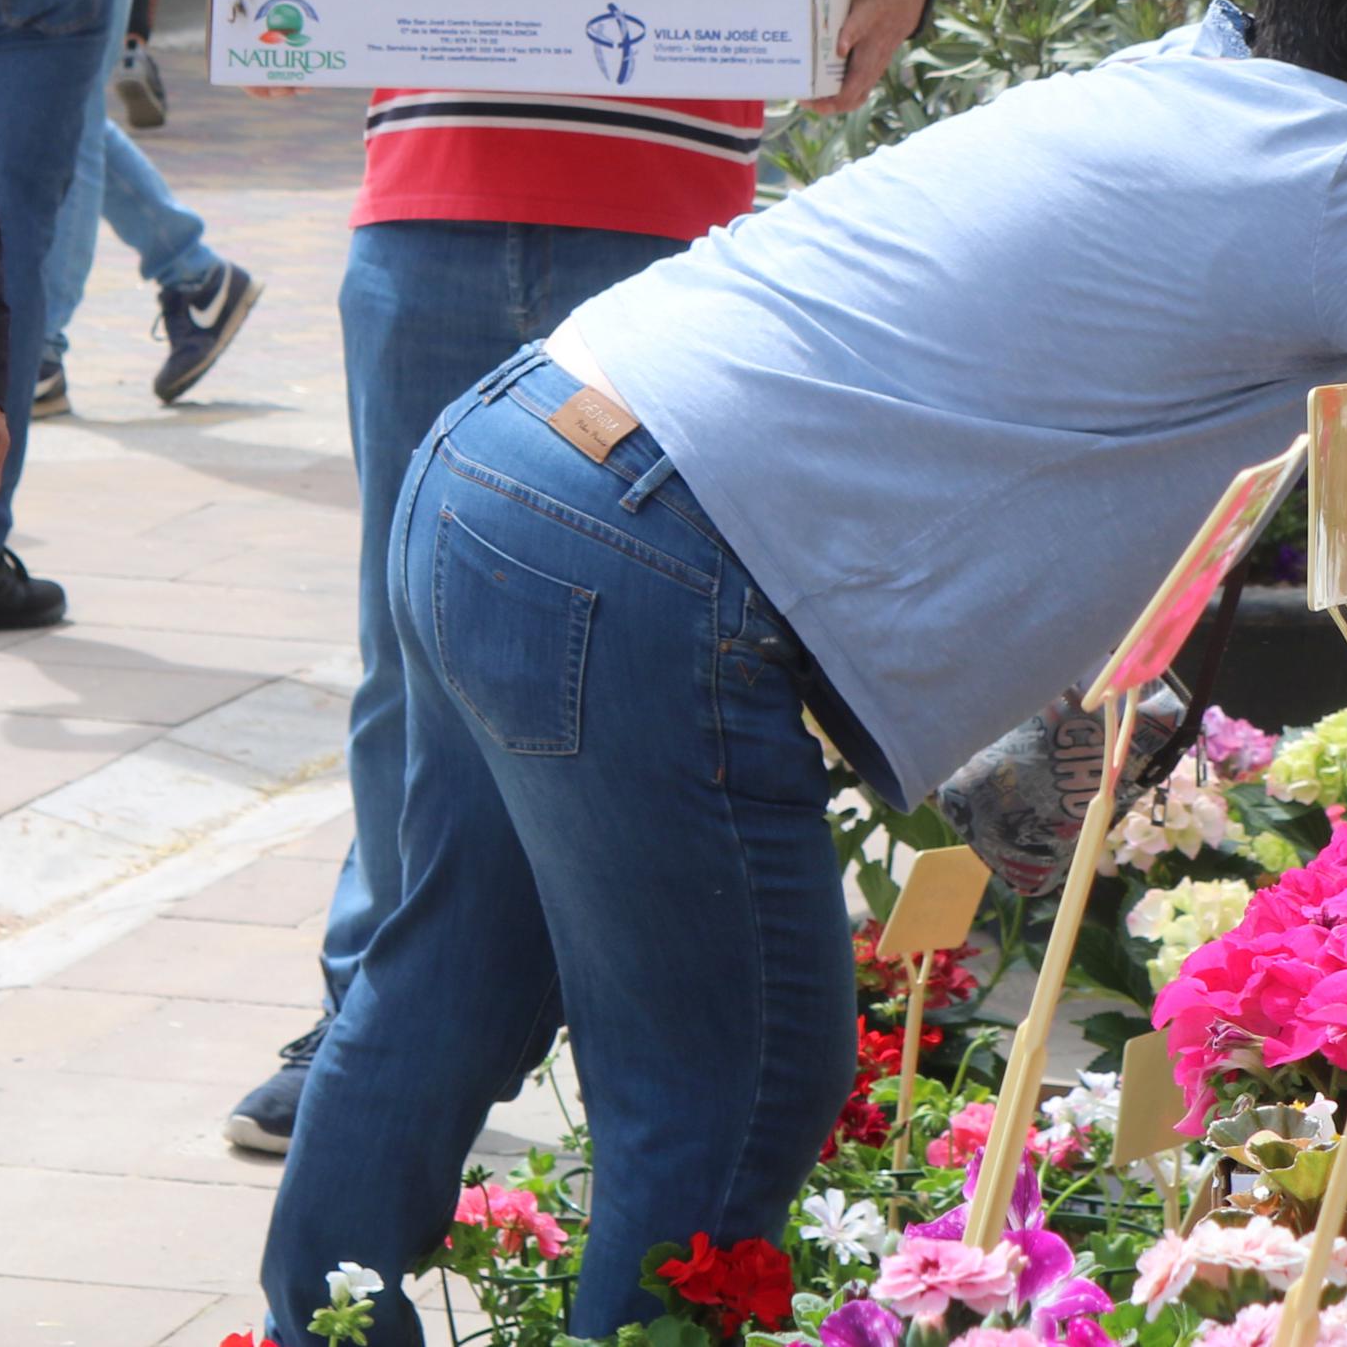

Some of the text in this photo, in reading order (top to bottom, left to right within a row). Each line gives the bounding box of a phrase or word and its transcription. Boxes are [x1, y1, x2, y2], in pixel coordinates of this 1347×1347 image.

[654, 29, 690, 40] VILLA
[694, 29, 721, 41] SAN
[724, 26, 758, 42] JOSÉ
[654, 43, 683, 53] Vivero
[692, 44, 718, 53] Venta
[720, 45, 732, 54] de
[734, 45, 767, 56] plantas
[228, 48, 347, 73] NATURDIS
